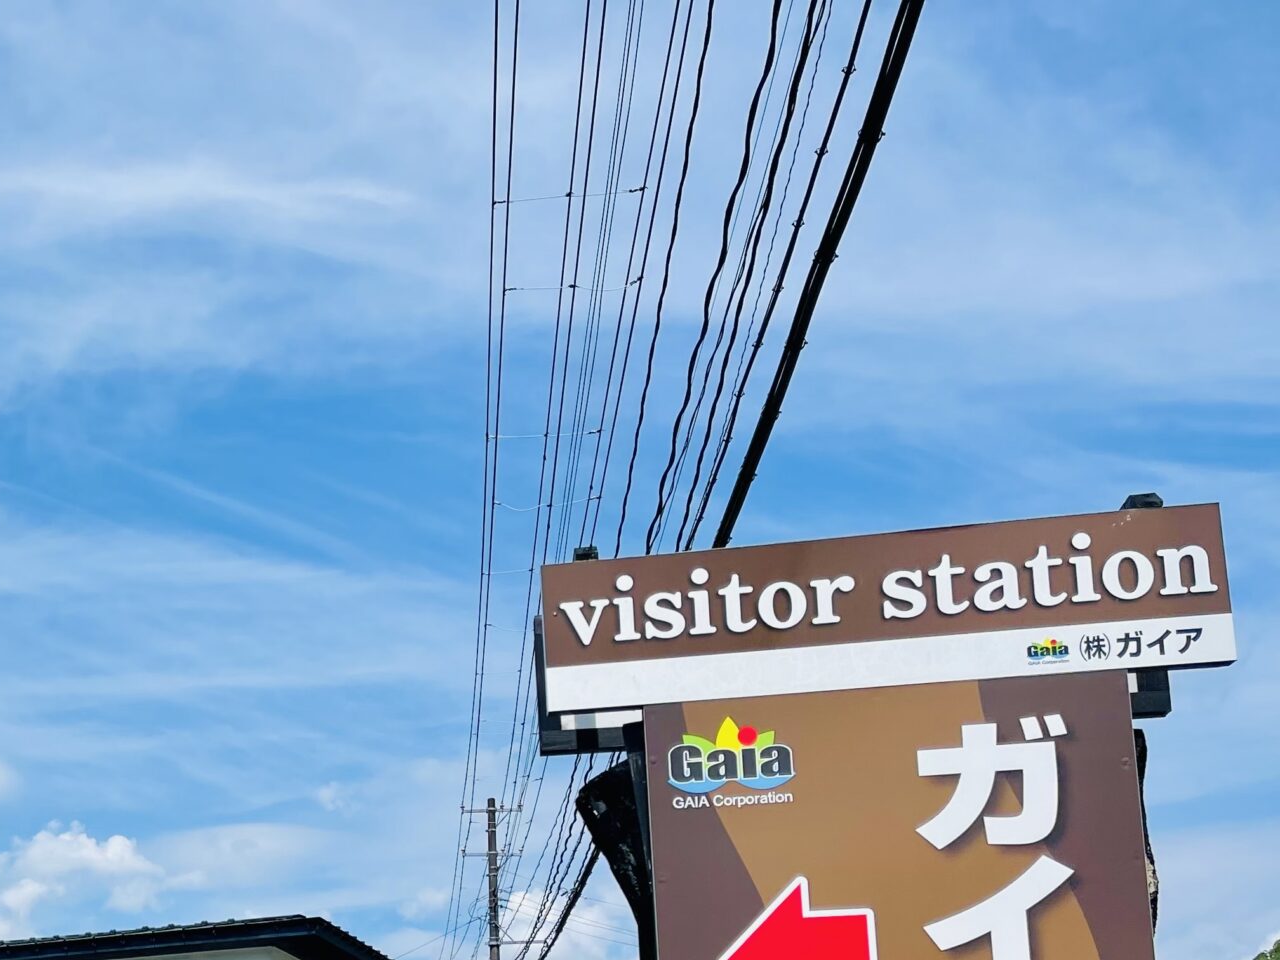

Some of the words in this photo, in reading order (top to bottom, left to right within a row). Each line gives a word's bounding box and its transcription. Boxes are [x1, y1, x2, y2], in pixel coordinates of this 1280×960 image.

[558, 568, 855, 647] visitor
[882, 532, 1219, 621] station
[1026, 639, 1070, 658] Gaia
[667, 725, 795, 785] Gaia
[672, 796, 710, 809] GAIA
[712, 791, 794, 808] Corporation
